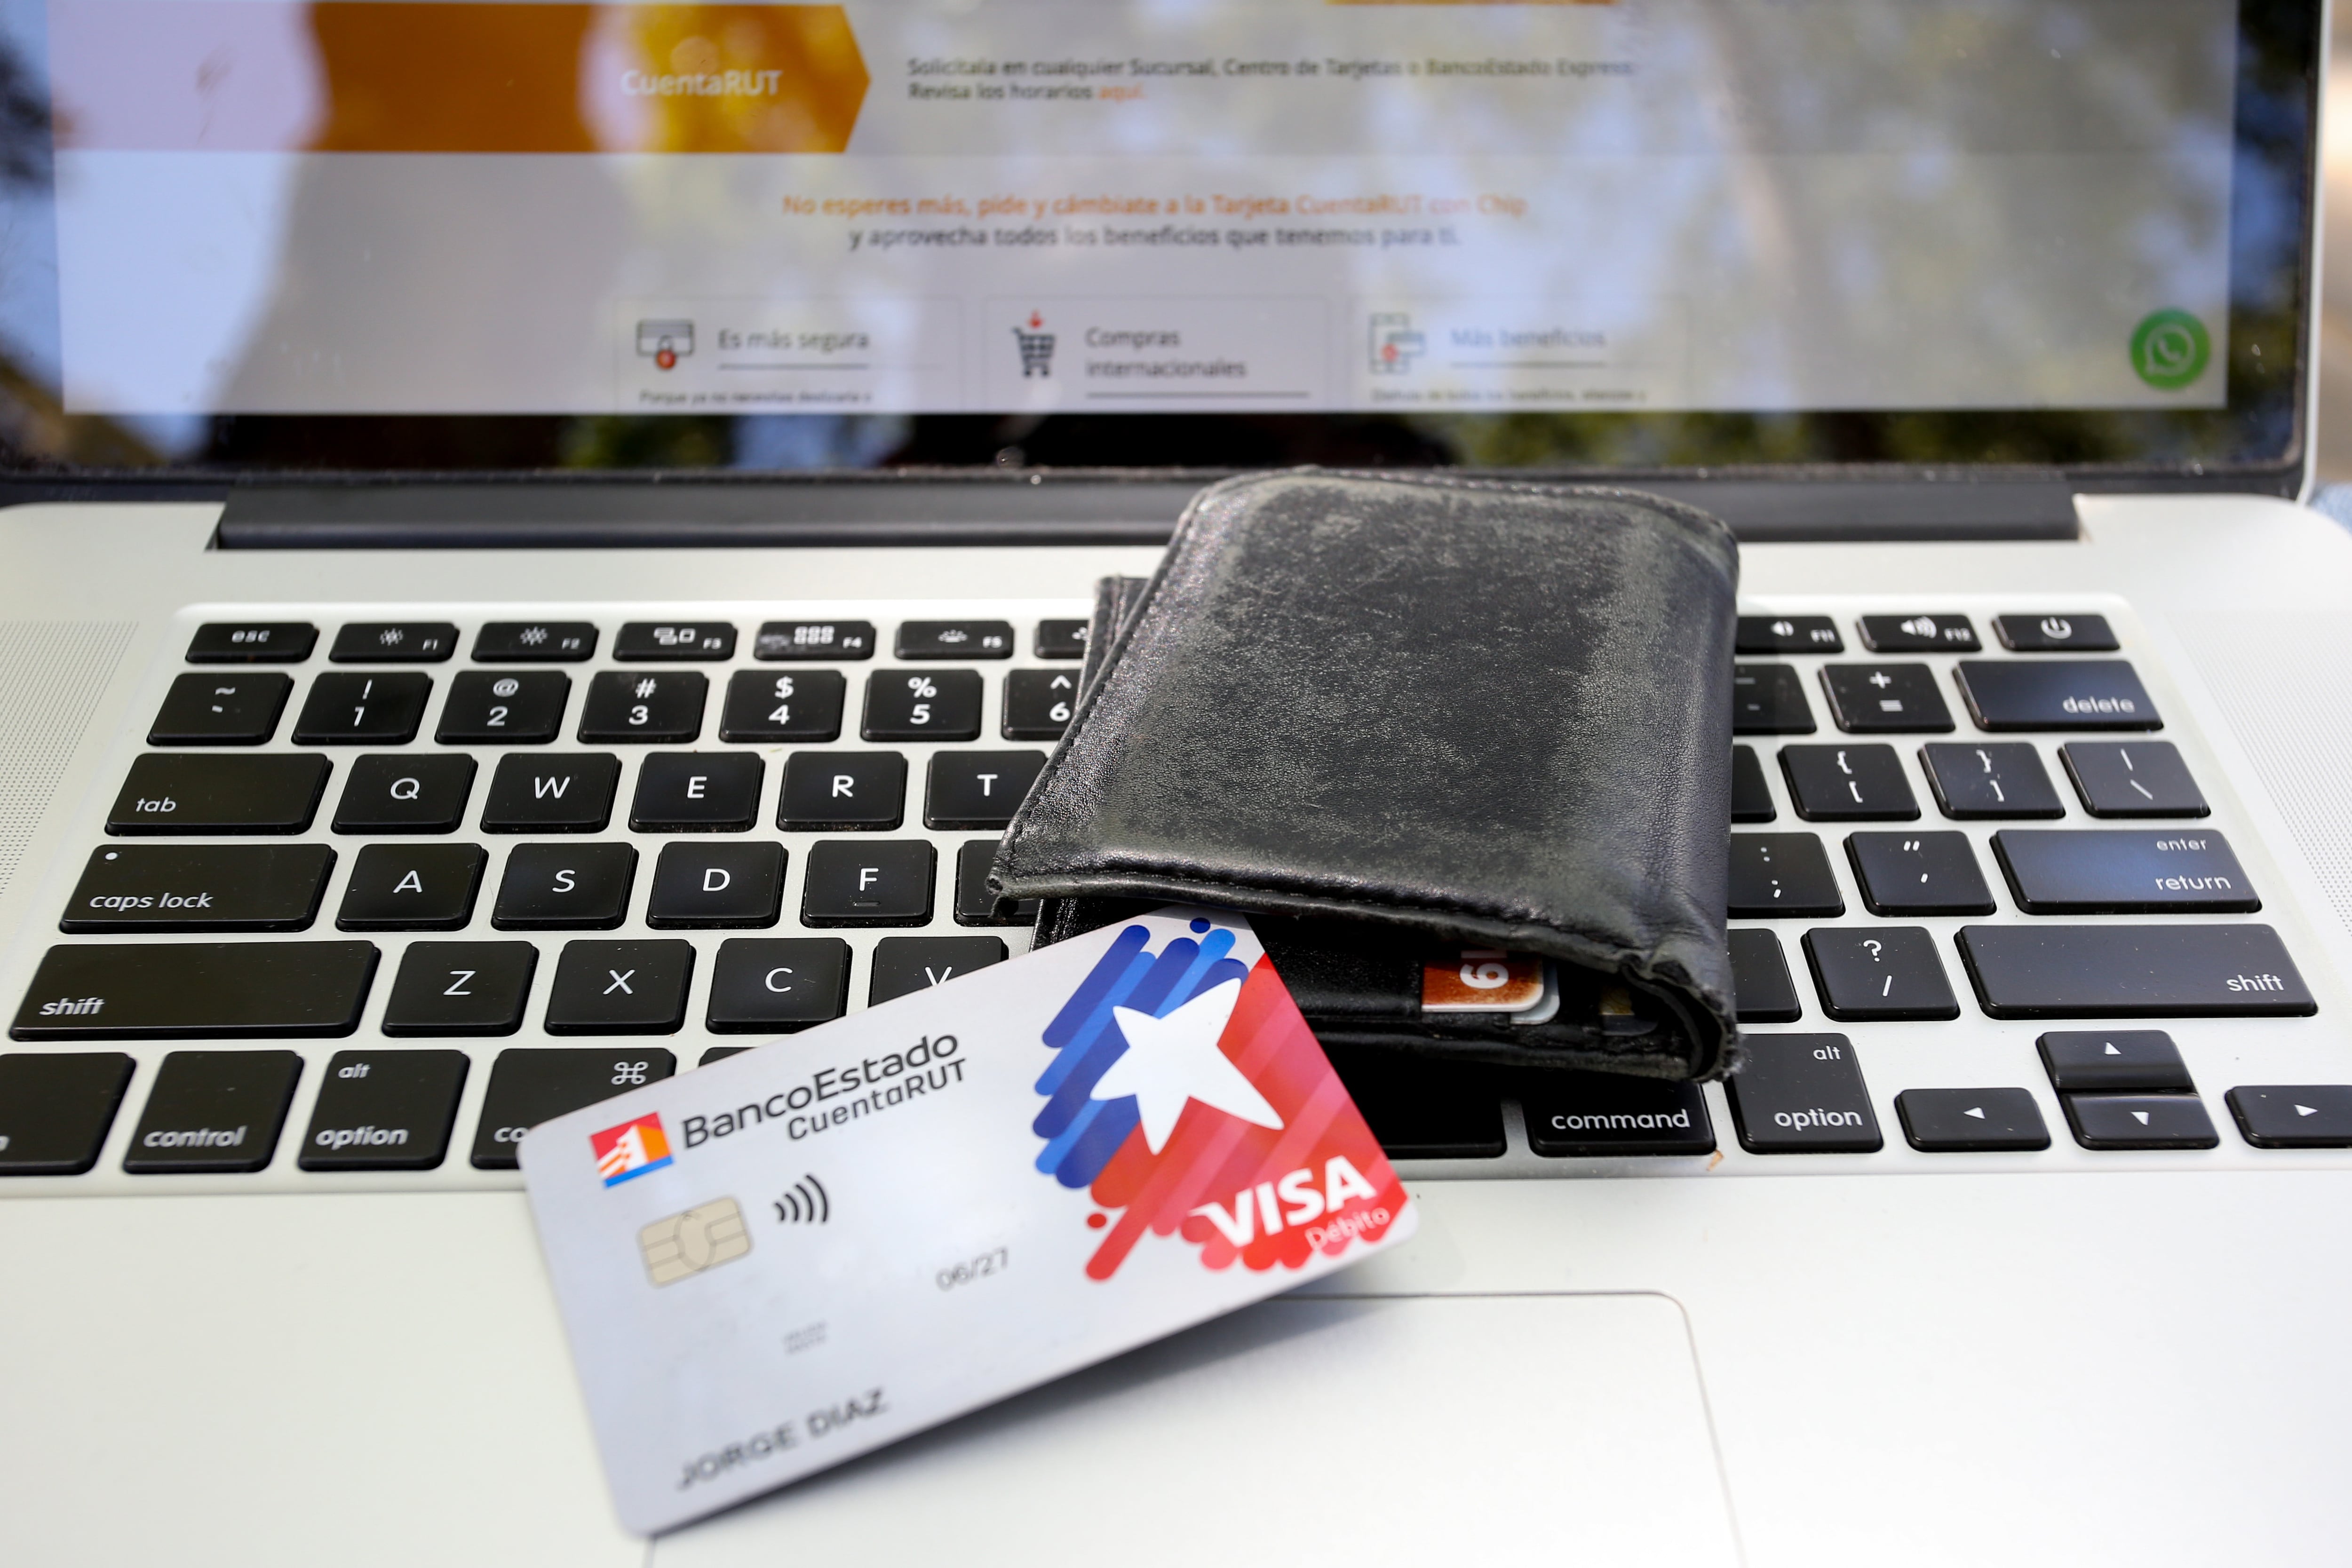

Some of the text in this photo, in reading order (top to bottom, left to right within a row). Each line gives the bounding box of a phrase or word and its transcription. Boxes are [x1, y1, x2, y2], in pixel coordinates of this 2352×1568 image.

[1002, 61, 1027, 76] en
[1032, 57, 1123, 79] cualquier
[1223, 57, 1291, 76] Centro
[1295, 57, 1320, 76] de
[620, 69, 783, 96] CuentaRUT
[907, 83, 972, 100] Revisa
[976, 83, 1006, 100] los
[1009, 83, 1093, 100] horarios
[782, 193, 1530, 220] No esperes más, pide y cámbiate a la Tarjeta CuentaRUT con Chip
[848, 230, 864, 251] y
[867, 228, 988, 250] aprovecha
[994, 227, 1058, 245] todos
[1064, 227, 1099, 245] los
[1103, 227, 1220, 245] beneficios
[1224, 230, 1269, 251] que
[1275, 228, 1376, 245] tenemos
[1380, 230, 1433, 251] para
[718, 328, 871, 355] Es más segura
[1084, 326, 1182, 352] Compras
[1498, 327, 1606, 348] beneficios
[1084, 357, 1249, 378] internacionales
[231, 631, 270, 642] esc
[423, 640, 438, 650] F1
[703, 638, 722, 649] F3
[842, 637, 862, 648] F4
[983, 636, 1002, 648] F5
[363, 680, 372, 699] !
[493, 679, 519, 697] @
[636, 679, 656, 698] #
[775, 676, 794, 699] $
[908, 677, 937, 698] %
[628, 705, 648, 725] 3
[768, 705, 790, 725] 4
[910, 704, 930, 724] 5
[1049, 701, 1071, 722] 6
[2063, 697, 2134, 713] delete
[354, 706, 365, 726] 1
[487, 706, 508, 726] 2
[390, 777, 420, 800] Q
[535, 776, 570, 799] W
[687, 776, 707, 799] E
[832, 775, 854, 798] R
[977, 774, 998, 796] T
[136, 797, 176, 812] tab
[2156, 838, 2206, 851] enter
[393, 870, 422, 893] A
[552, 870, 575, 893] S
[703, 868, 731, 891] D
[859, 868, 879, 891] F
[2155, 875, 2231, 890] return
[90, 892, 214, 911] caps lock
[1863, 940, 1882, 962] ?
[443, 970, 476, 995] Z
[603, 969, 635, 995] X
[765, 967, 793, 992] C
[924, 966, 953, 986] V
[2226, 974, 2284, 991] shift
[39, 997, 104, 1015] shift
[1813, 1045, 1841, 1060] alt
[338, 1063, 370, 1078] alt
[681, 1032, 959, 1149] BancoEstado
[787, 1057, 967, 1141] CuentaRUT
[1551, 1109, 1690, 1129] command
[1774, 1108, 1863, 1131] option
[144, 1126, 246, 1147] control
[316, 1126, 408, 1150] option
[1189, 1155, 1377, 1249] VISA
[1304, 1207, 1391, 1252] Débito
[935, 1247, 1009, 1291] 06/27
[676, 1386, 888, 1491] JORGE DIAZ
